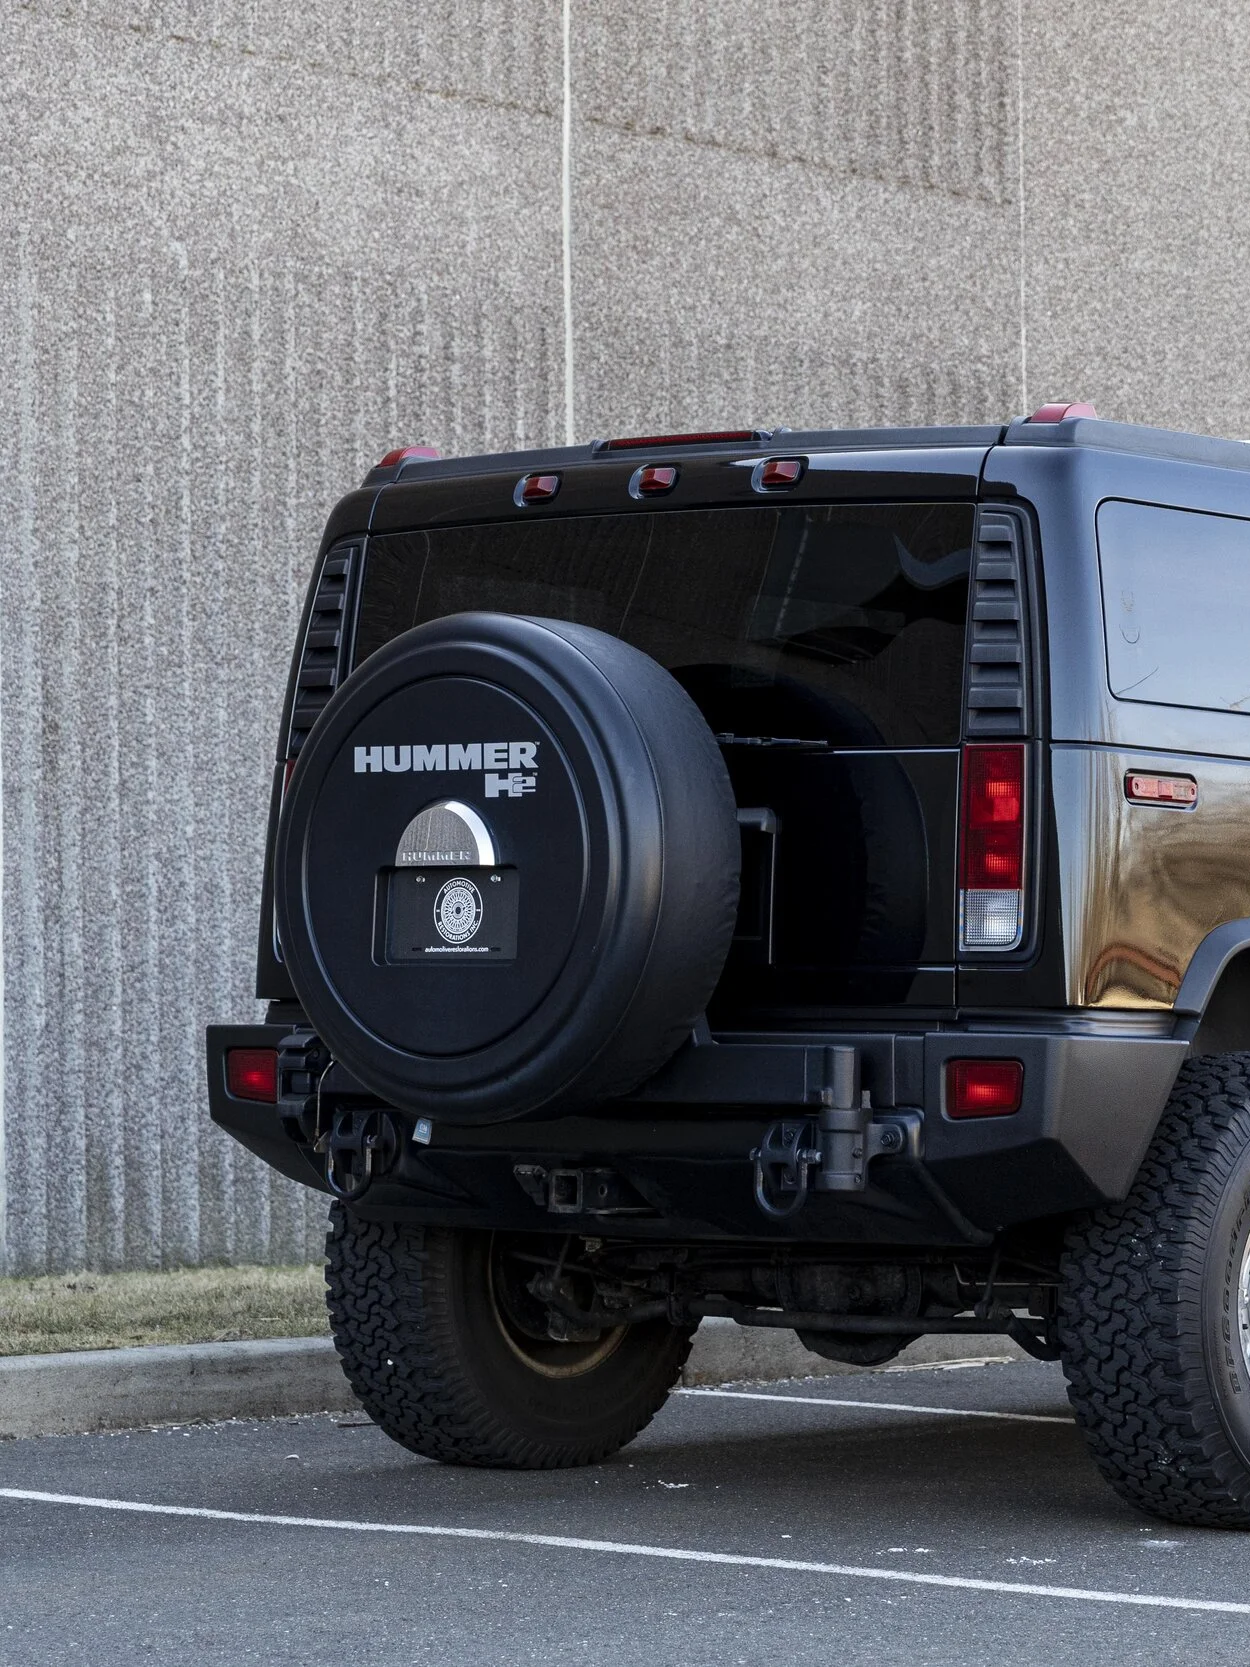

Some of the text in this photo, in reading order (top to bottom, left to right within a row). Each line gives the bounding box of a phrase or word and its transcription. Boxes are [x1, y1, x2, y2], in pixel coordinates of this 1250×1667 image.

[354, 742, 538, 772] HUMMER
[485, 773, 536, 797] H2
[402, 850, 472, 861] HUMMER
[443, 880, 476, 894] AUTOMOTIVE
[438, 921, 471, 941] RESTORATIONS
